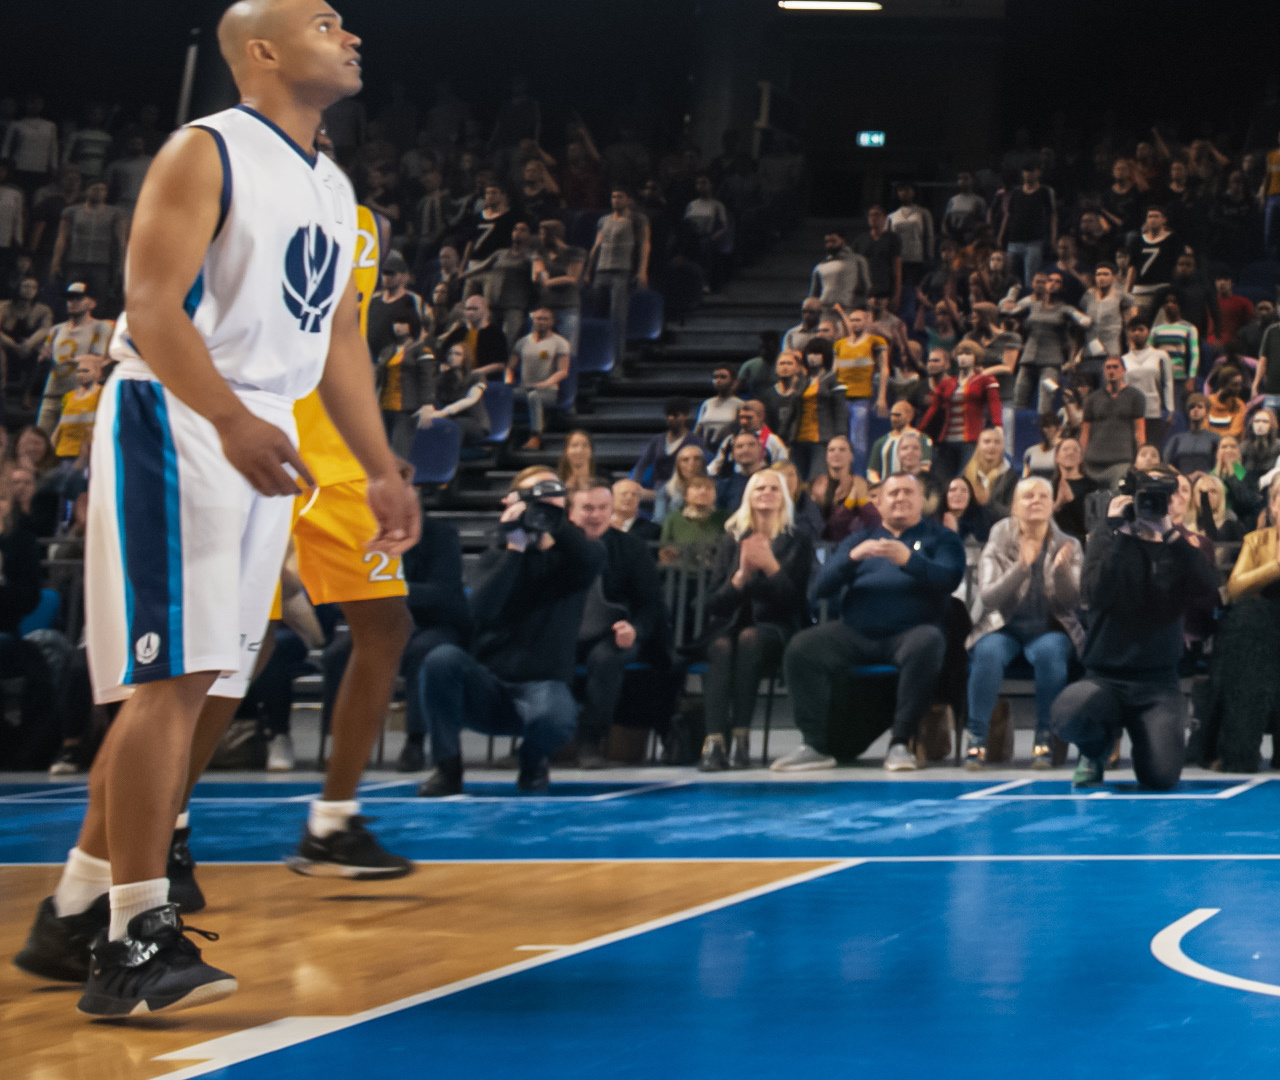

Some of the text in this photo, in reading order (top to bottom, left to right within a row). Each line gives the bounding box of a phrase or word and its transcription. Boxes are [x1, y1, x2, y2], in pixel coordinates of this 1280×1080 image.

[351, 228, 377, 269] 2
[475, 223, 496, 250] 7
[1141, 247, 1161, 276] 7
